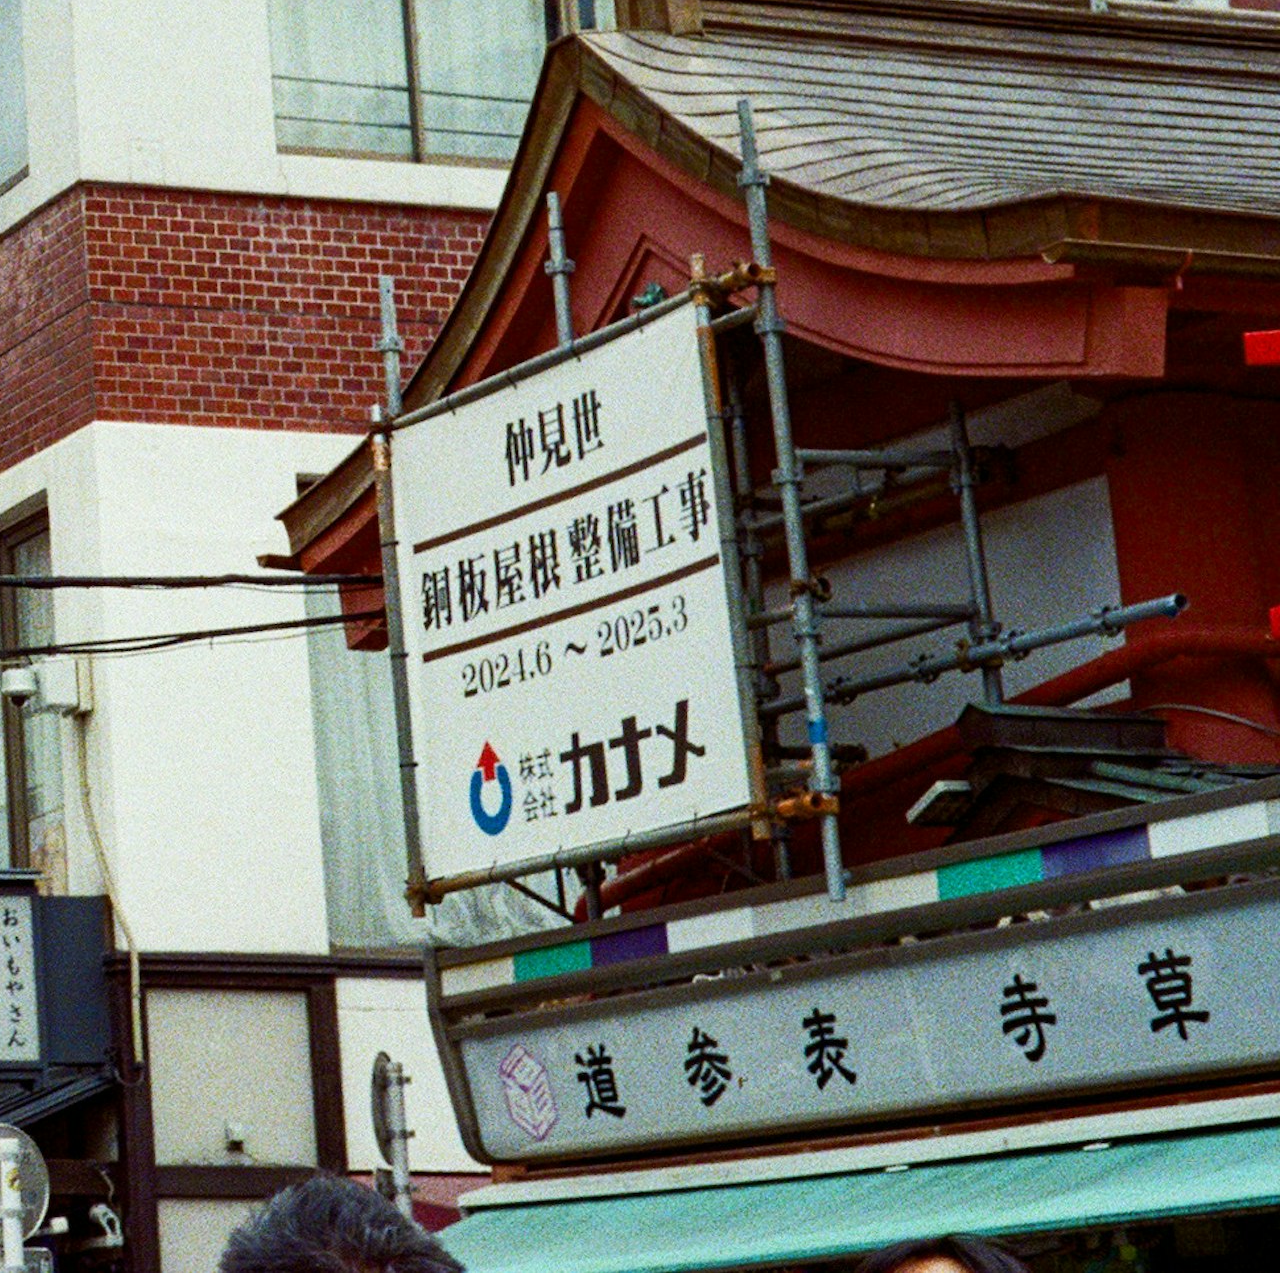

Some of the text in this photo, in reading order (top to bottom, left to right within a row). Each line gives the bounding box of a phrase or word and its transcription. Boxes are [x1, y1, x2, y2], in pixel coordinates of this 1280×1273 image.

[505, 389, 604, 487] 仲見世
[461, 640, 553, 699] 2024.6
[597, 594, 689, 658] 2025.3
[559, 699, 706, 816] カナメ
[2, 907, 26, 1048] おいもやさん
